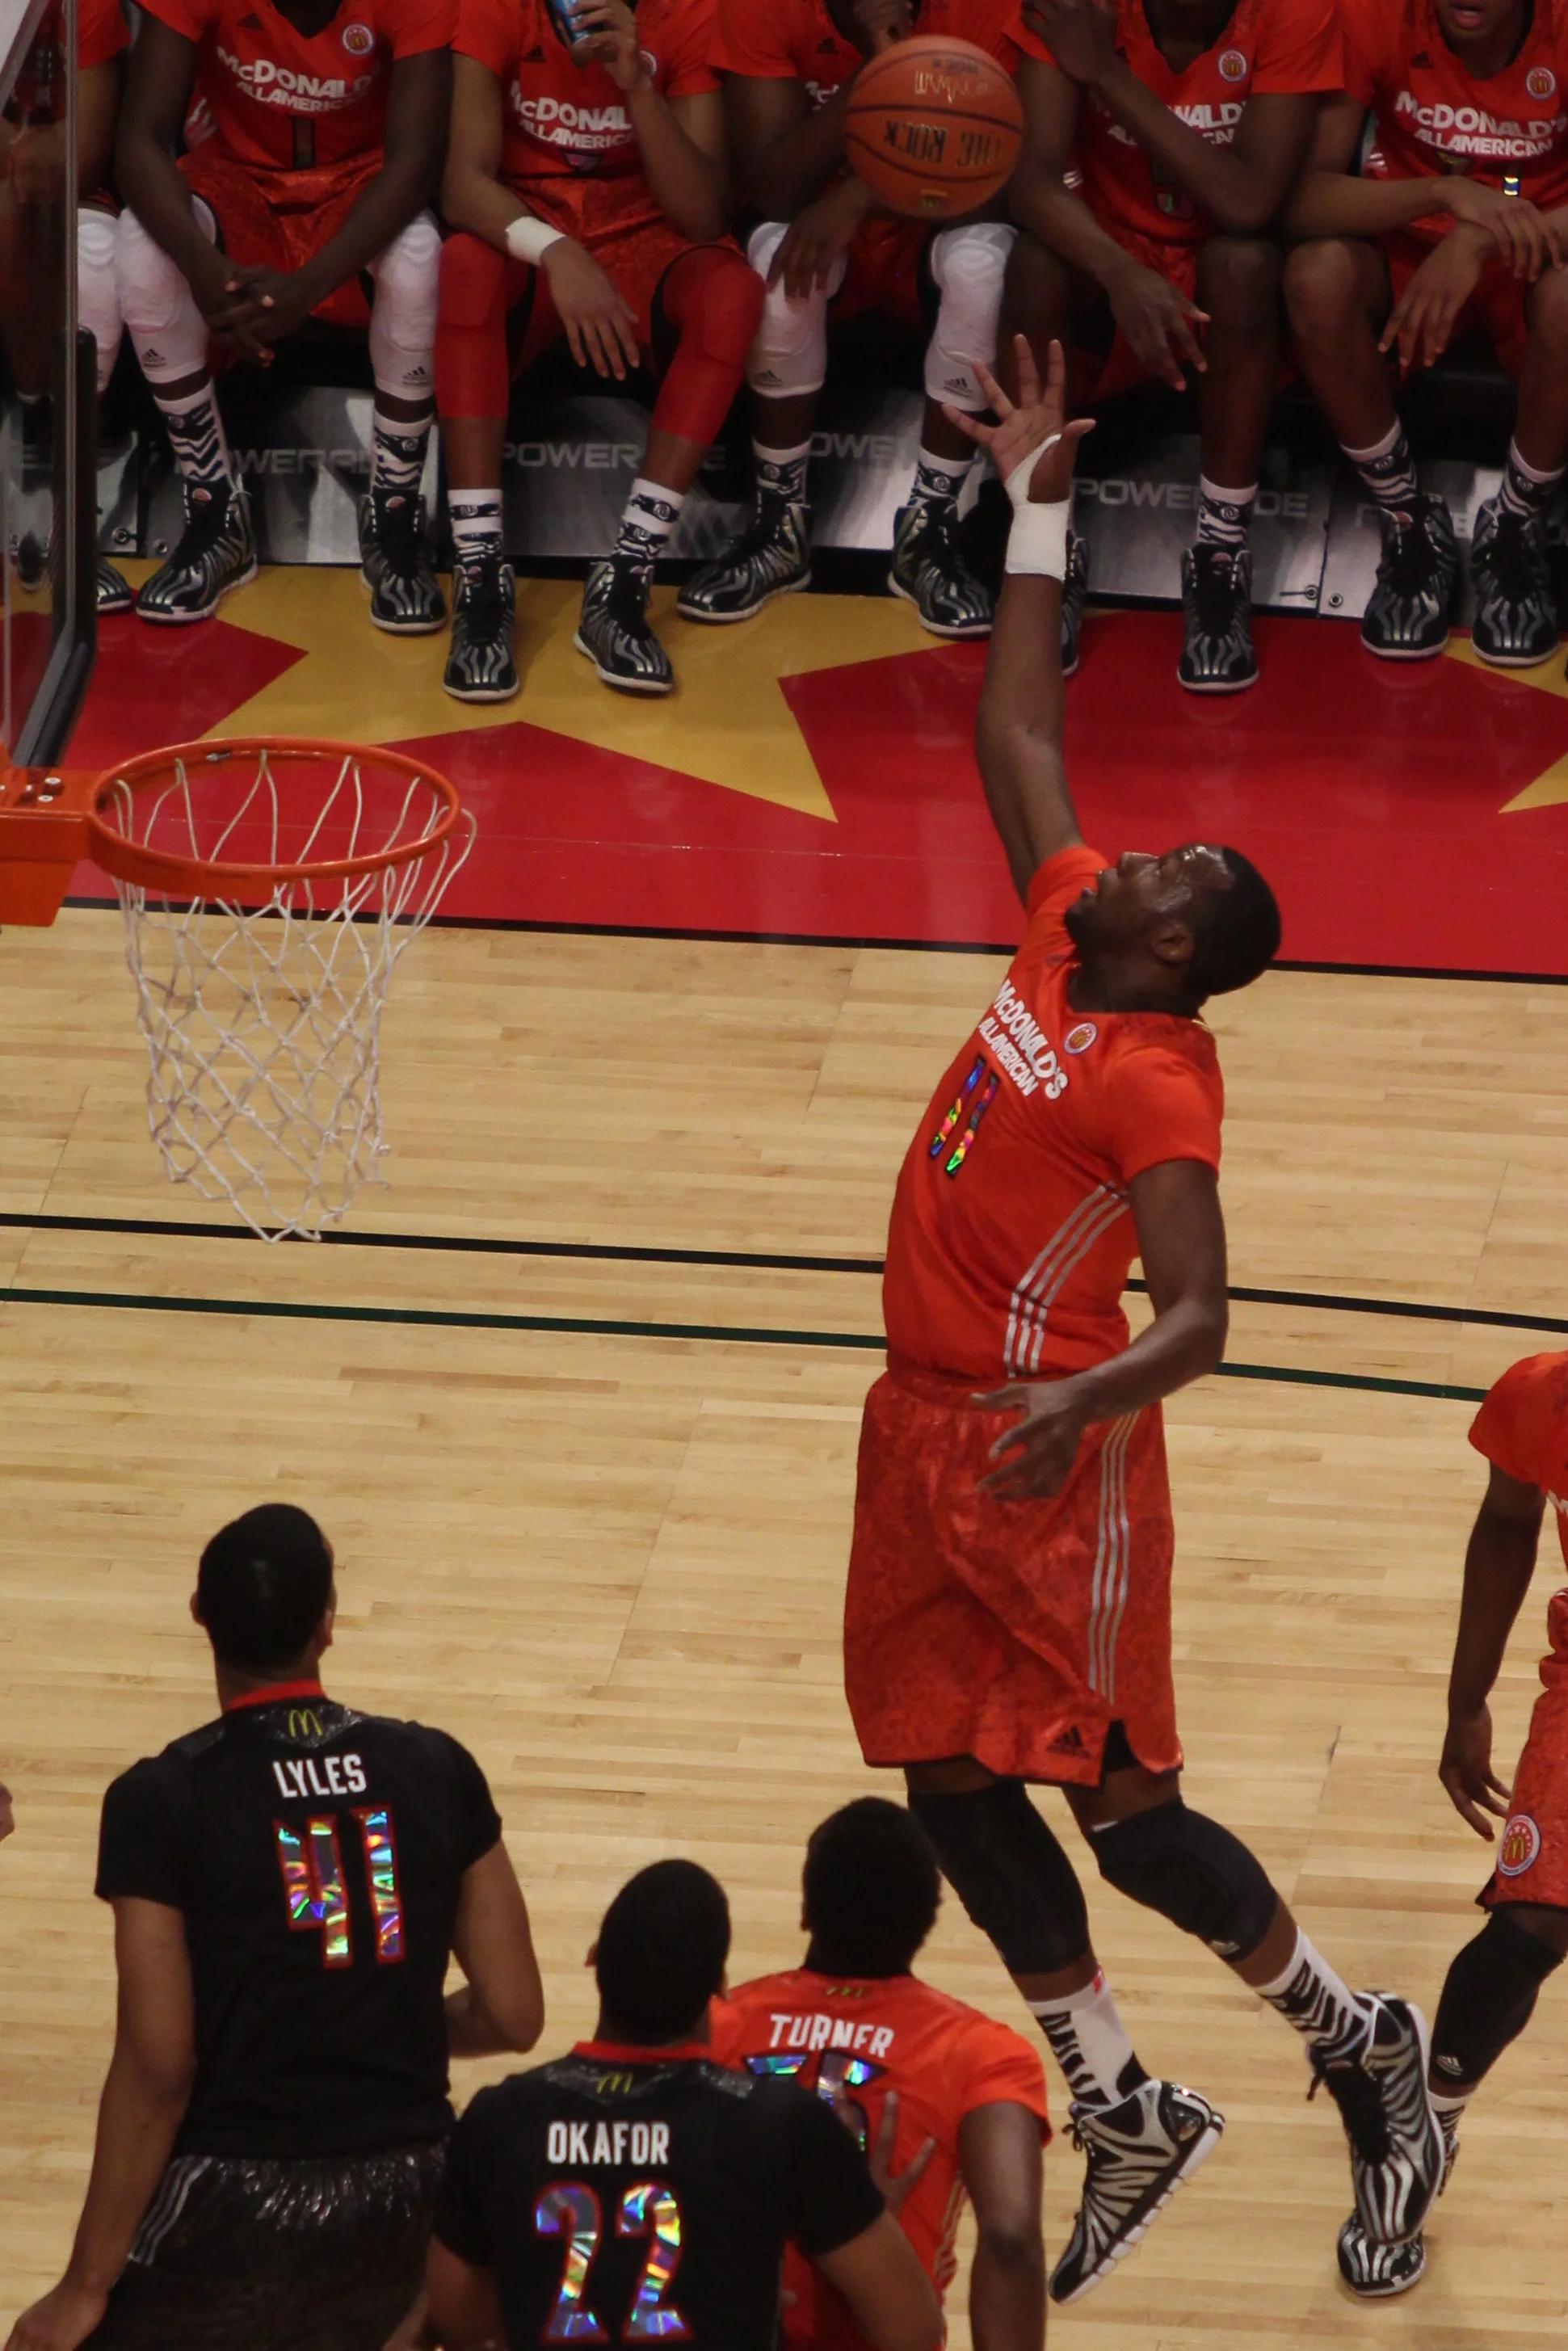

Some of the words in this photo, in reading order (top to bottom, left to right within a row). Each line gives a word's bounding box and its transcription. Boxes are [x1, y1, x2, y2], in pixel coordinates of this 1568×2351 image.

[1070, 477, 1309, 519] POWEDE
[993, 978, 1070, 1100] McDONALD'S
[271, 1753, 368, 1799] LYLES
[272, 1802, 407, 1969] 41
[768, 2012, 895, 2059] TURNER
[546, 2120, 671, 2167] OKAFOR
[530, 2181, 696, 2348] 22
